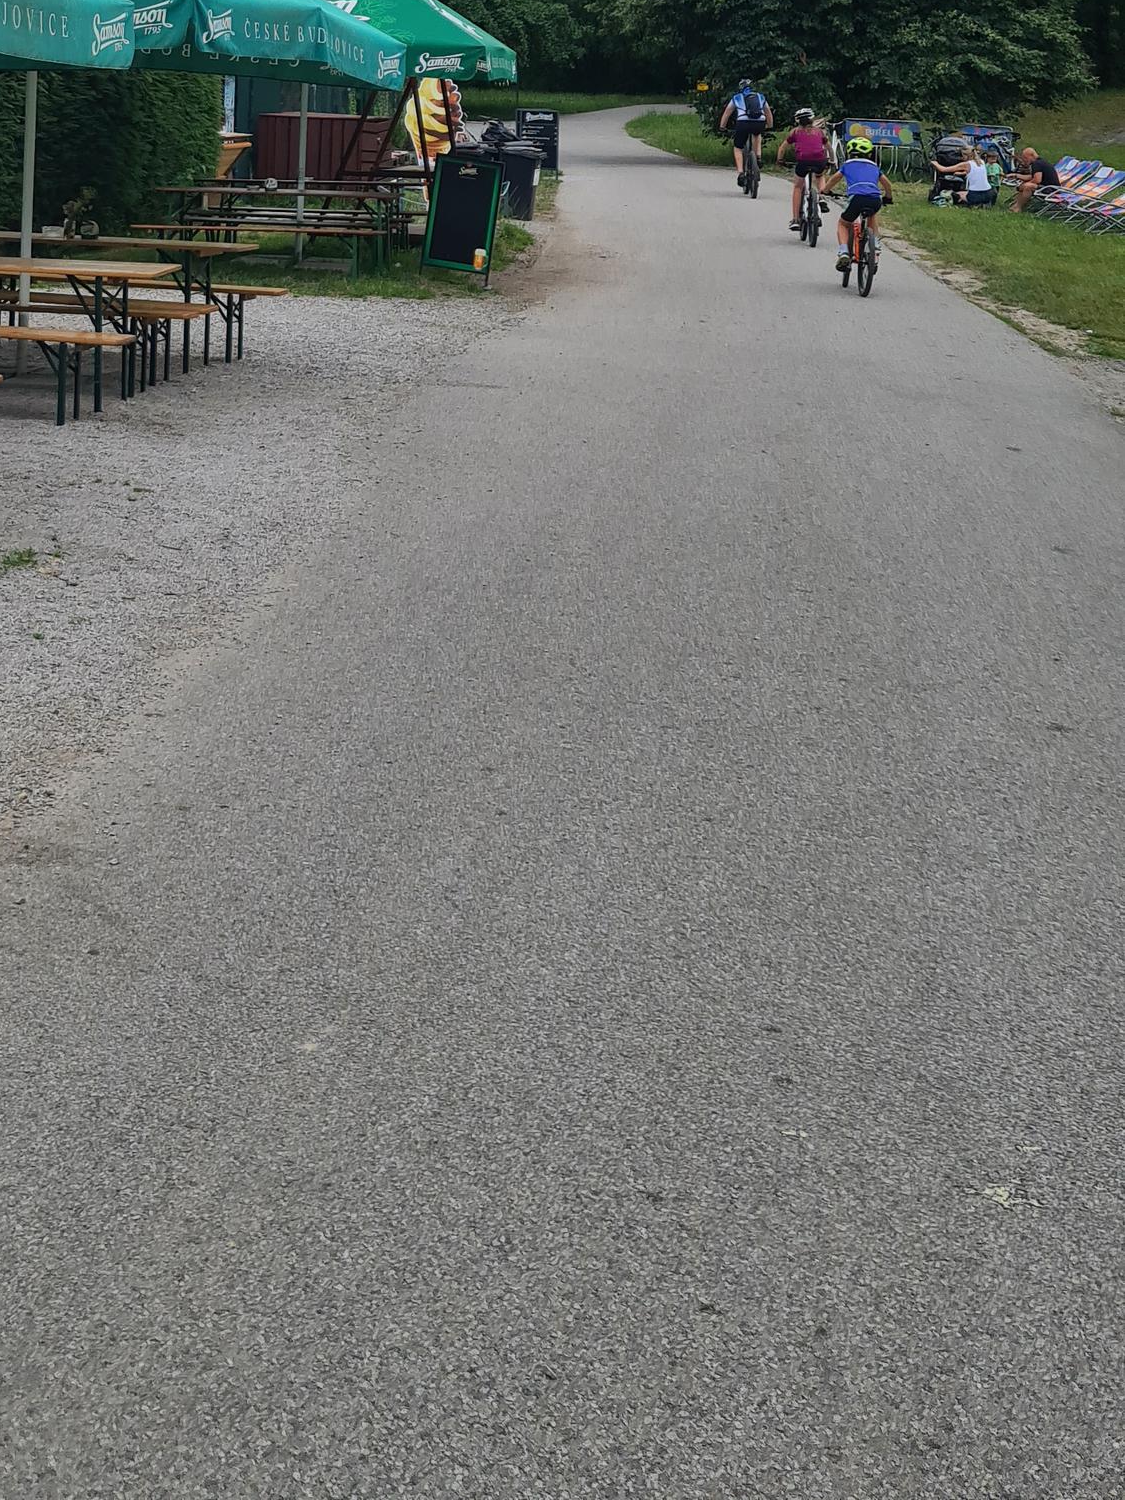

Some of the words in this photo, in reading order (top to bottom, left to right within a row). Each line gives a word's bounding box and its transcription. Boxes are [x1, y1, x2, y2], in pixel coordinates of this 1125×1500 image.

[144, 26, 162, 35] 1795
[244, 18, 290, 42] ČESKÉ
[414, 52, 467, 74] Samson
